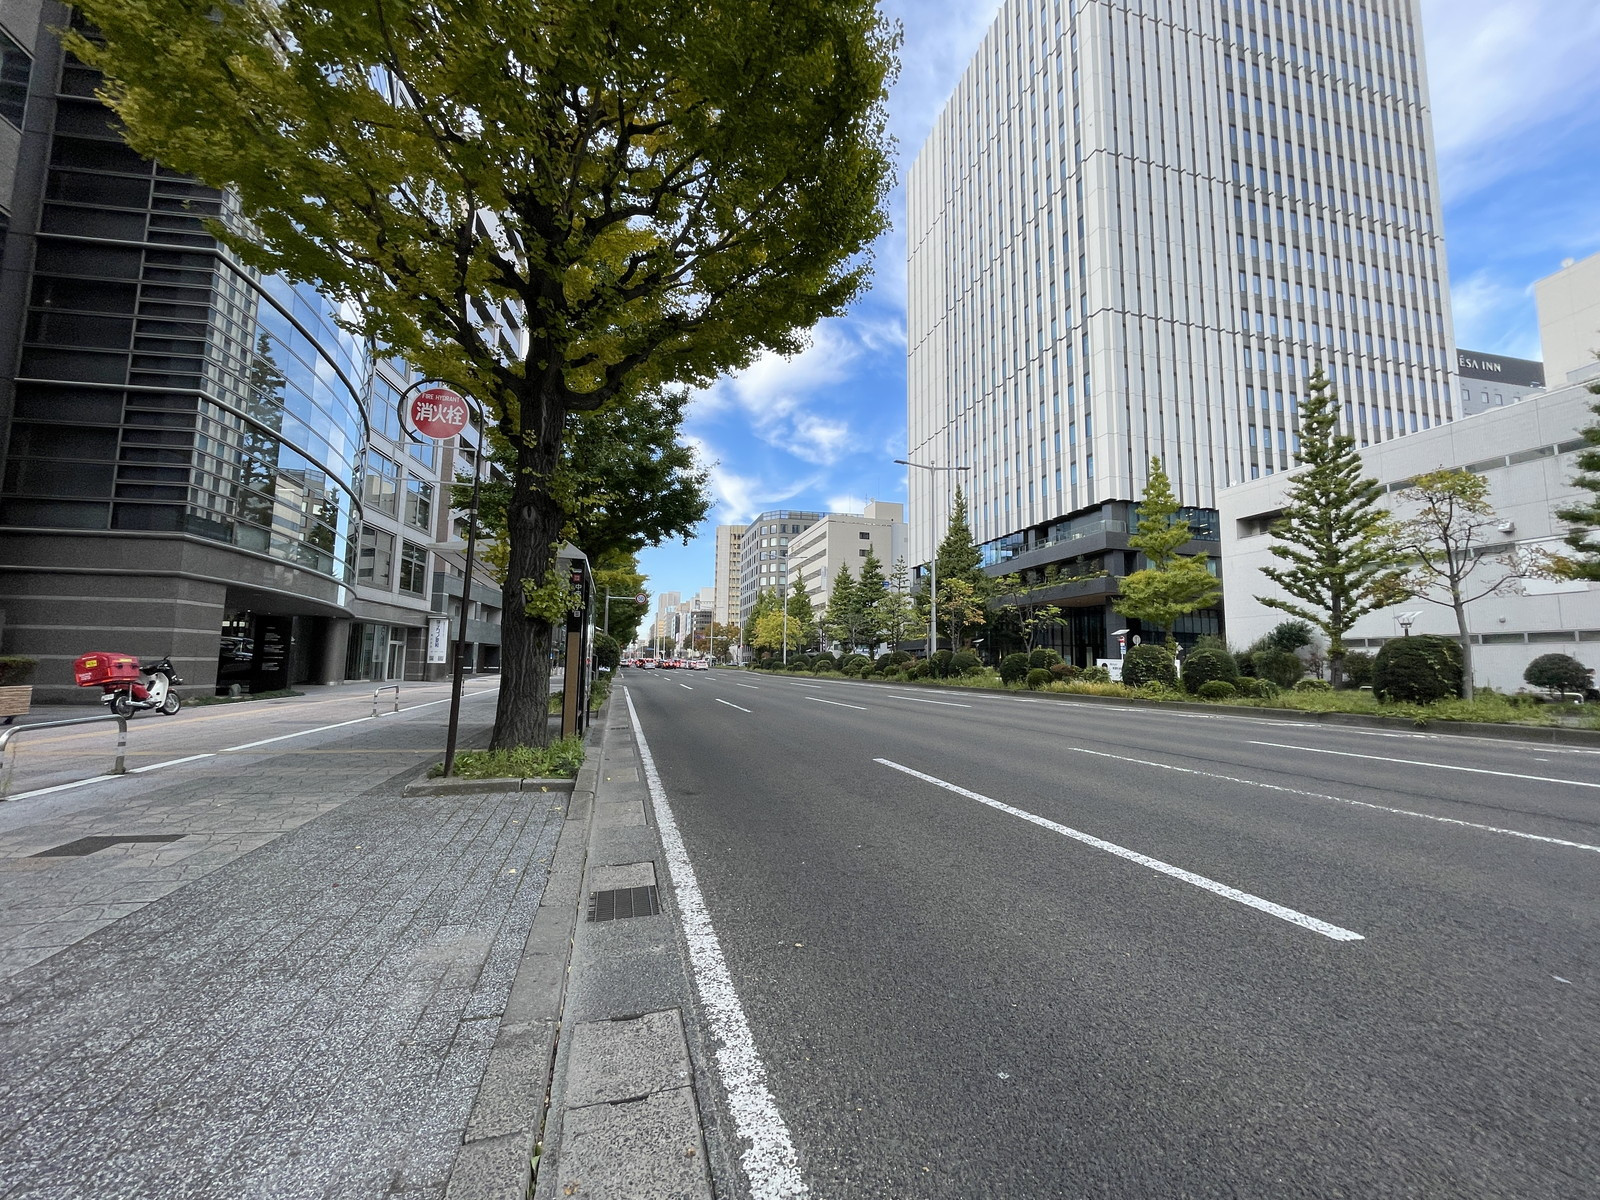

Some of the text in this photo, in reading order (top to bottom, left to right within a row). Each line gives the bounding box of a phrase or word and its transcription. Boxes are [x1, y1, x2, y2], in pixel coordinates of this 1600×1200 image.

[1482, 361, 1501, 372] INN
[435, 394, 460, 403] HYDRANT
[415, 401, 464, 425] 消火栓
